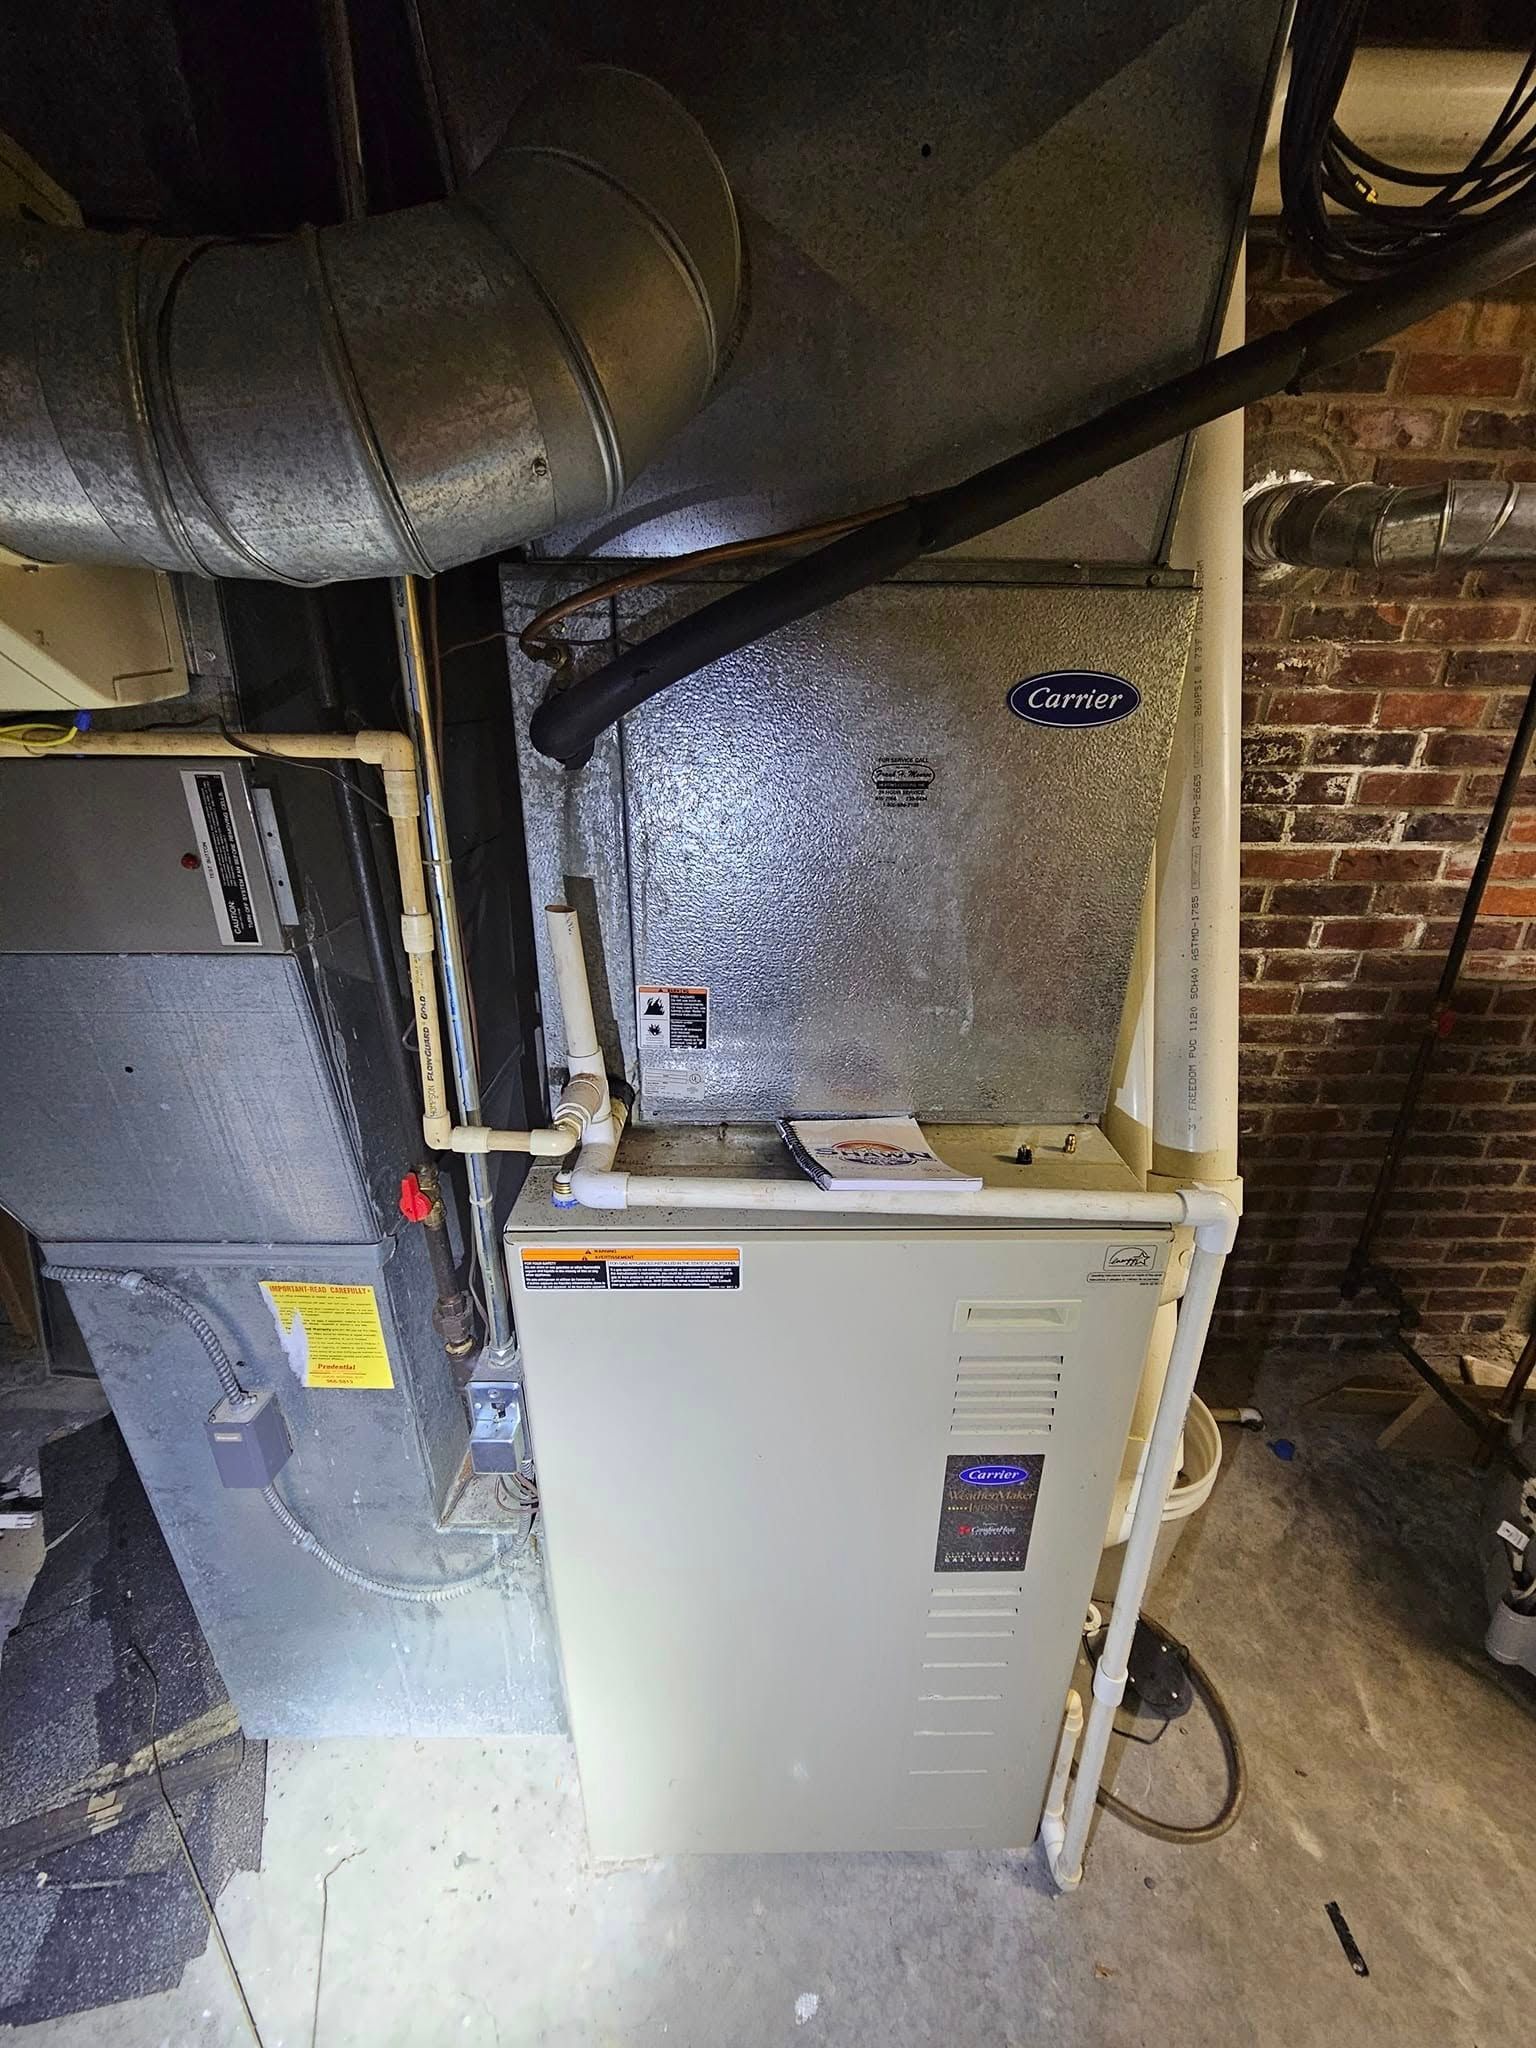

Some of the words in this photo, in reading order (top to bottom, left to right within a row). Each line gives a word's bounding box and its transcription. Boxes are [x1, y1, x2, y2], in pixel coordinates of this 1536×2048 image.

[1027, 686, 1124, 710] Carrier
[243, 902, 251, 914] OFF
[1191, 895, 1200, 961] ASTMD-1785
[1190, 967, 1199, 1000] SCH40
[1189, 1006, 1198, 1032] 1120
[1188, 1039, 1198, 1059] PVC
[1188, 1064, 1197, 1111] FREEDOM
[814, 1146, 933, 1160] SHAWN
[317, 1363, 356, 1371] Prudential
[968, 1469, 1020, 1480] Carrier
[949, 1490, 1035, 1501] WeatherMaker
